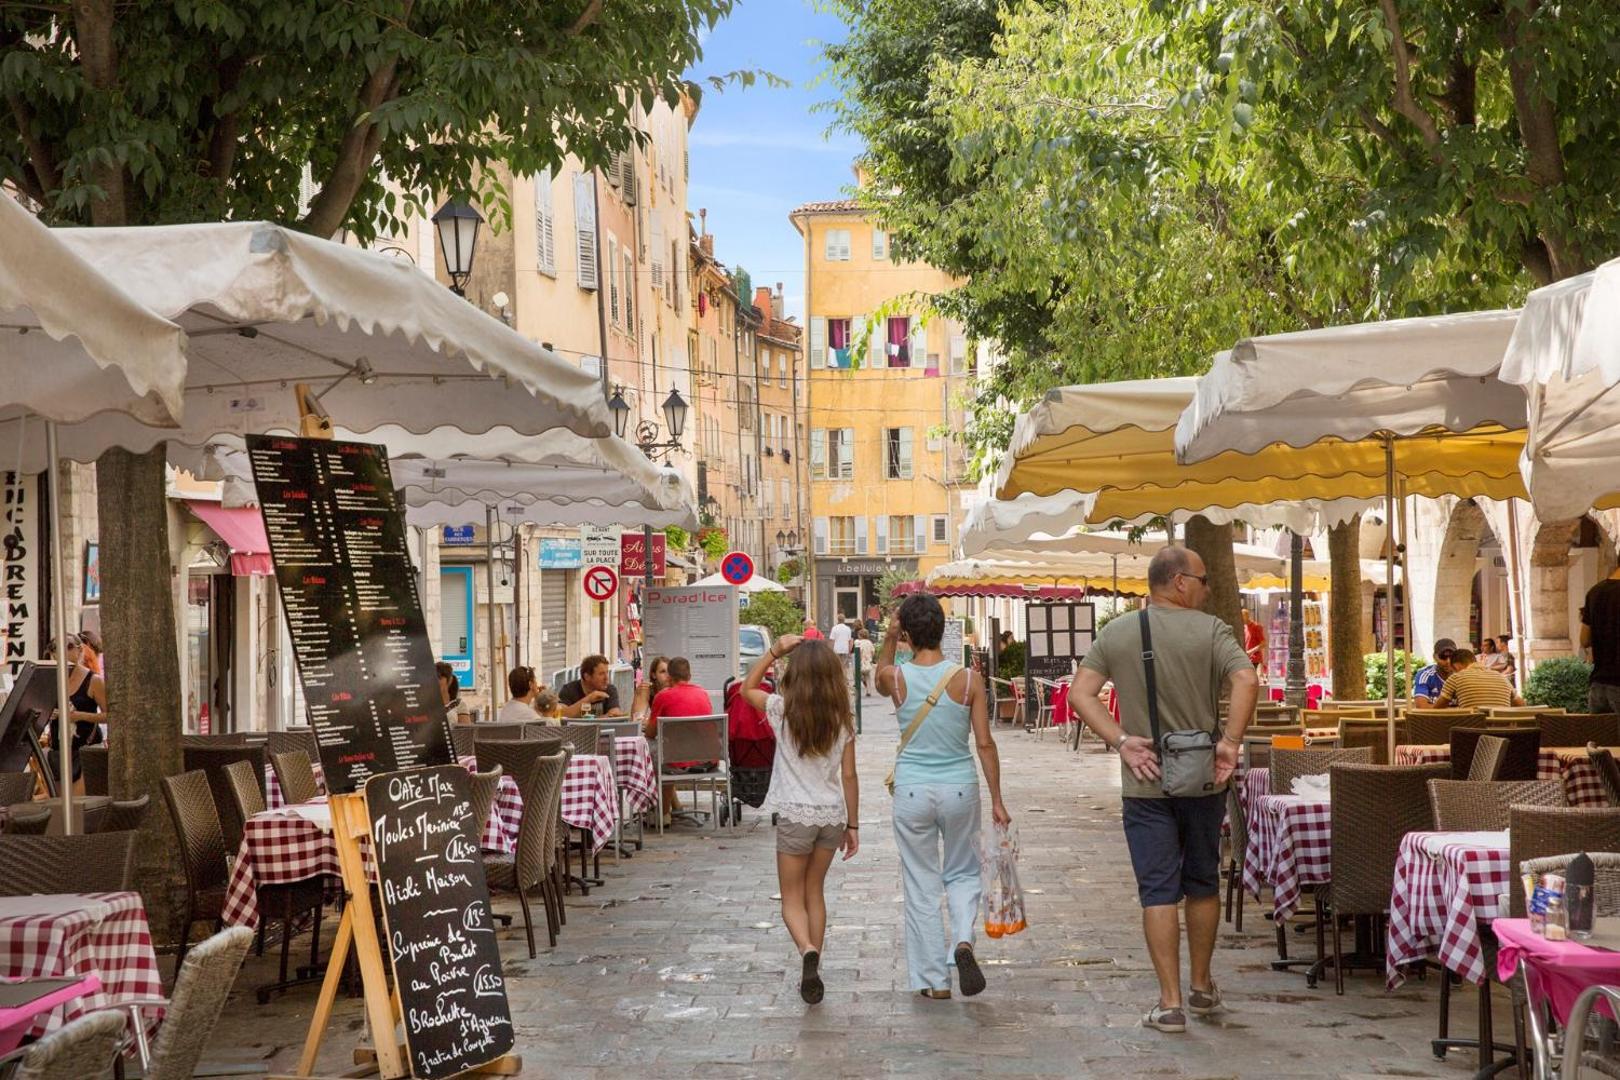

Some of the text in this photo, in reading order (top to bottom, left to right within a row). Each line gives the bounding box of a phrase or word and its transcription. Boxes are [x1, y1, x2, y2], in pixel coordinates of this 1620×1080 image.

[596, 556, 616, 564] PLACE
[624, 557, 660, 571] Déo
[428, 773, 454, 804] Max
[425, 866, 473, 895] Maison
[447, 922, 466, 943] de
[439, 939, 478, 965] Poulet
[411, 961, 471, 991] au Poivre
